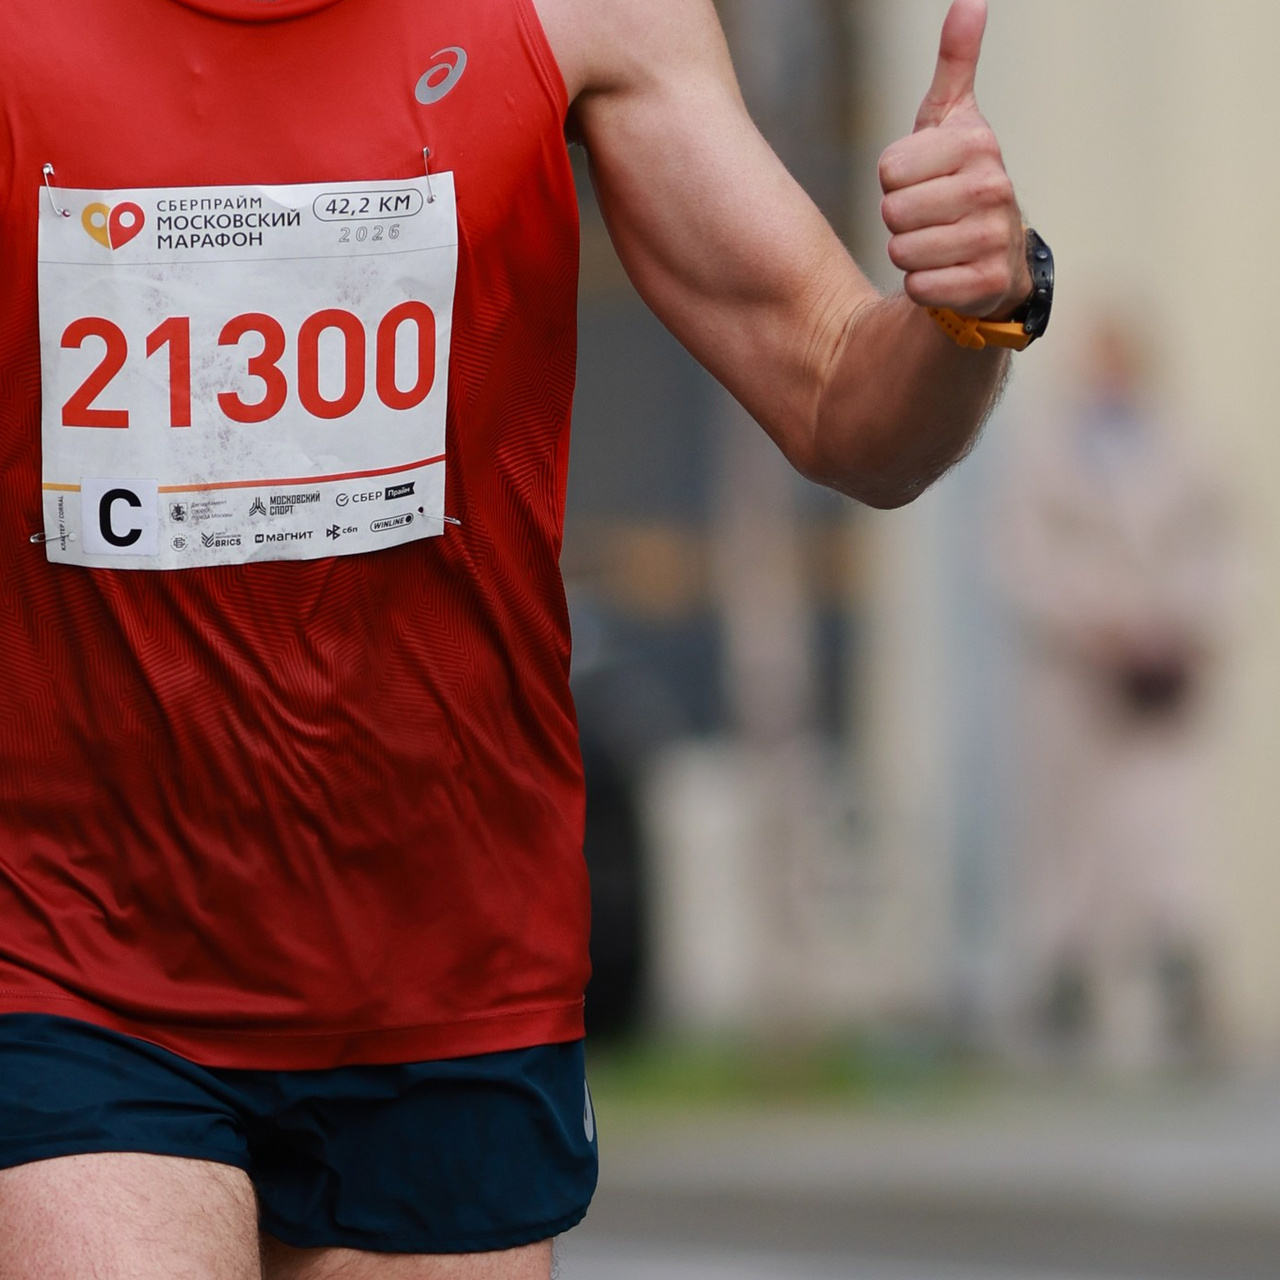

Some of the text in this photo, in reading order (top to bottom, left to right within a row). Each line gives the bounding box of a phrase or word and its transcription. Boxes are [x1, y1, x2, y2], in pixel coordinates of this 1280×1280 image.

[157, 195, 262, 212] СБЕРПРАЙМ
[325, 197, 370, 216] 42,2
[157, 209, 301, 231] МОСКОВСКИЙ
[339, 224, 401, 242] 2026
[157, 232, 263, 249] МАРАФОН
[60, 301, 436, 429] 21300
[270, 491, 321, 505] МОСКОВСКИЙ
[352, 491, 383, 503] СБЕР
[270, 505, 294, 516] СПОРТ
[342, 526, 358, 534] сбп
[373, 517, 405, 530] WINLINE
[215, 538, 242, 547] BRICS
[266, 531, 314, 542] магнит
